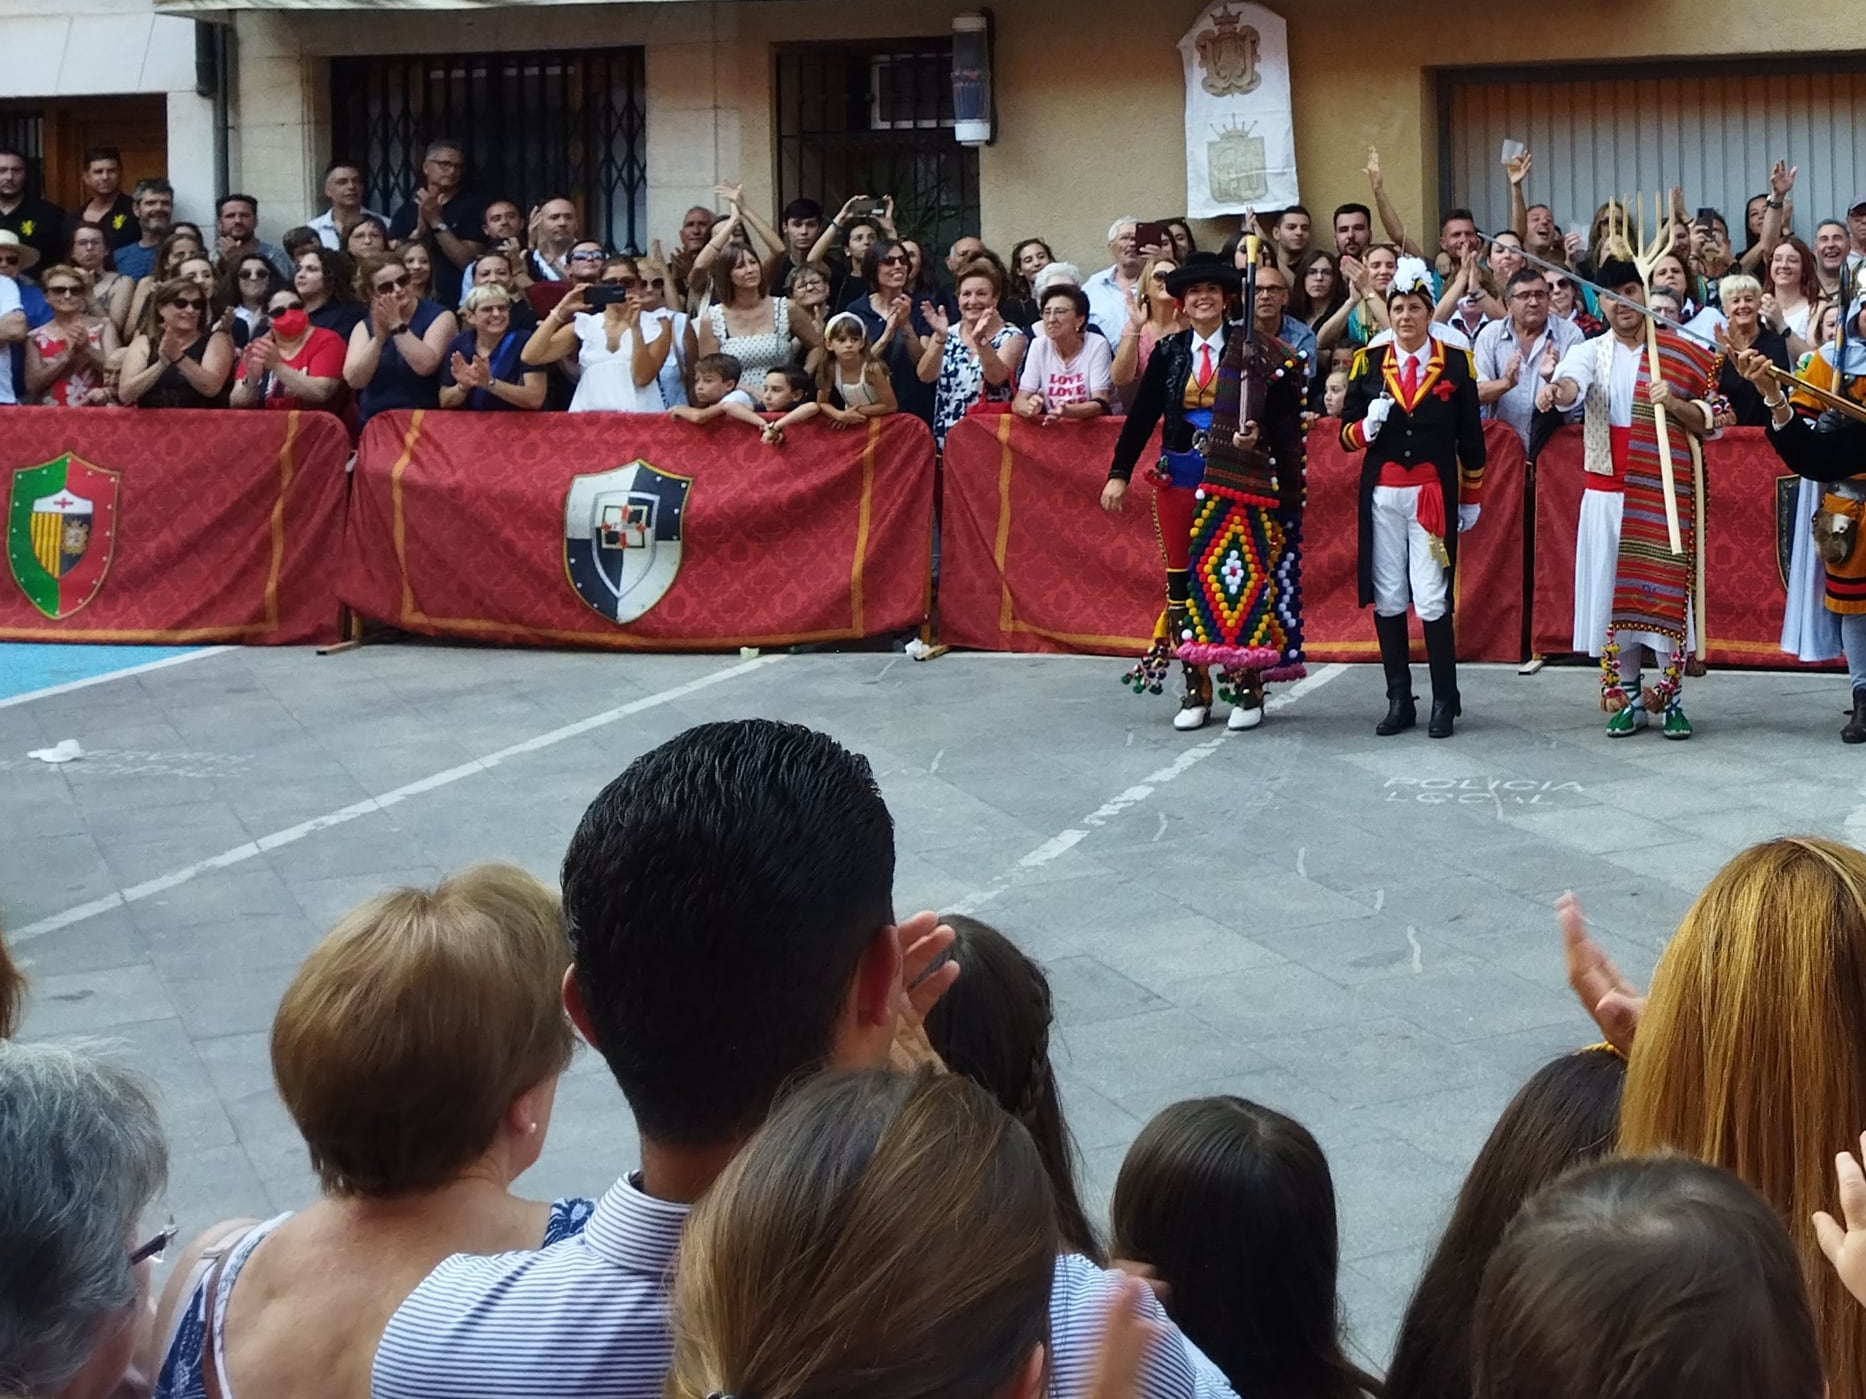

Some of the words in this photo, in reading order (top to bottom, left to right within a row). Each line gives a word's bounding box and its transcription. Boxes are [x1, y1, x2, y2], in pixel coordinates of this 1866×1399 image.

[1049, 373, 1084, 385] LOVE
[1048, 384, 1086, 397] LOVE
[1384, 777, 1585, 793] POLICIA
